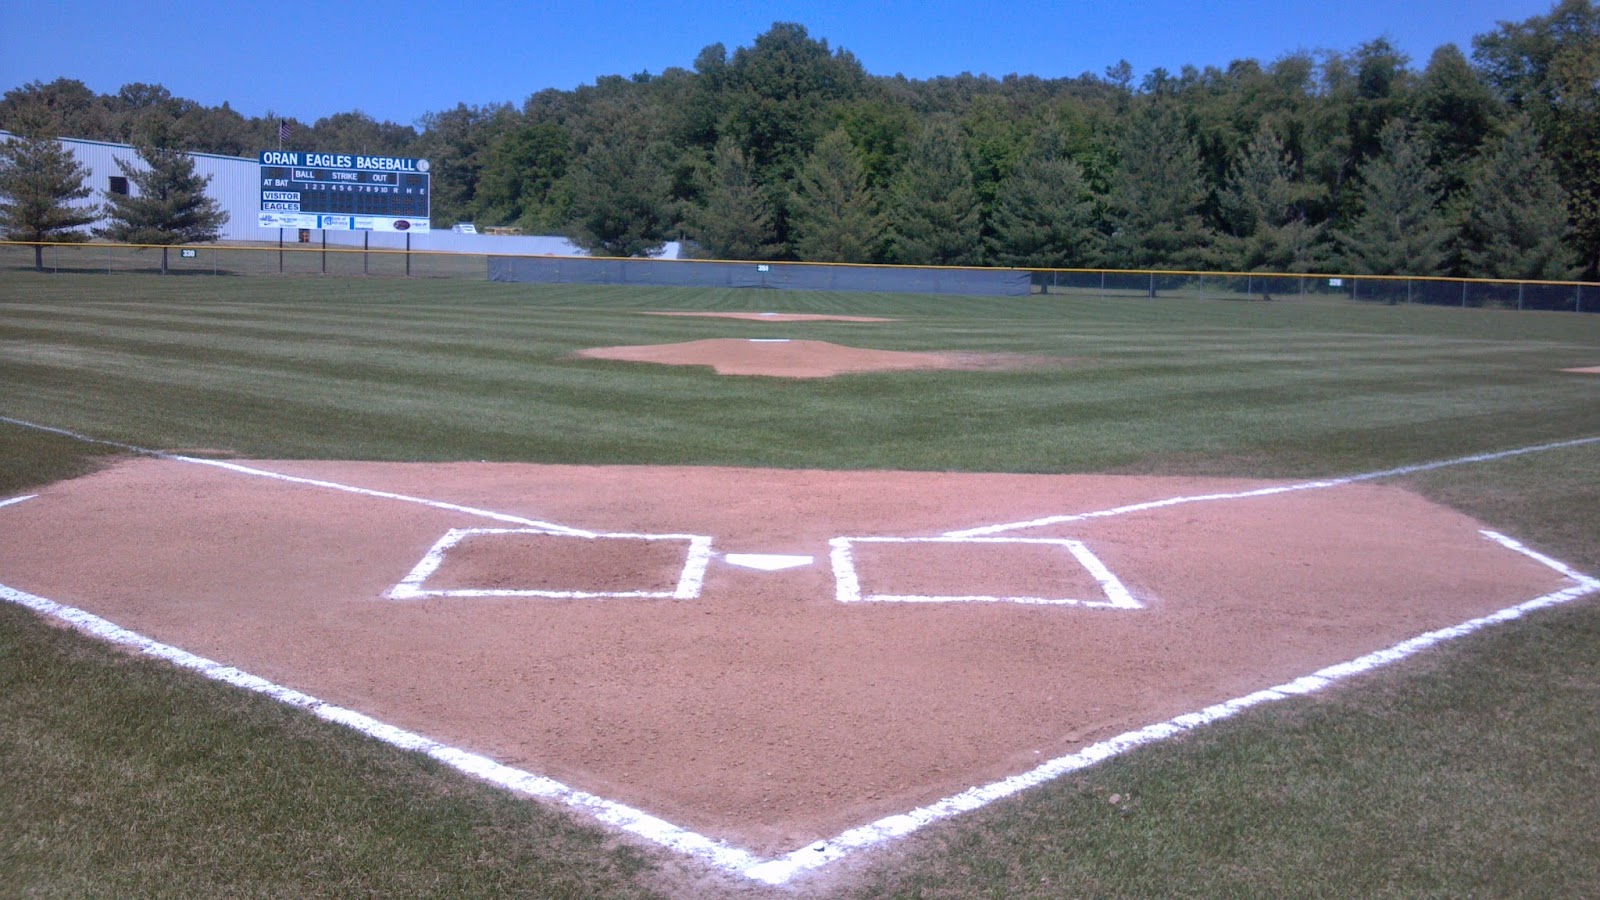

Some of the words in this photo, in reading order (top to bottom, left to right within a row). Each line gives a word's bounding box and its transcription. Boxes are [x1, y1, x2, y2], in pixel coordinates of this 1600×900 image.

[263, 152, 298, 165] ORAN
[306, 154, 352, 168] EAGLES
[356, 156, 415, 171] BASEBALL
[295, 170, 315, 178] BALL
[332, 172, 358, 180] STRIKE
[372, 174, 388, 182] OUT
[275, 179, 289, 187] BAT
[183, 249, 195, 257] 330
